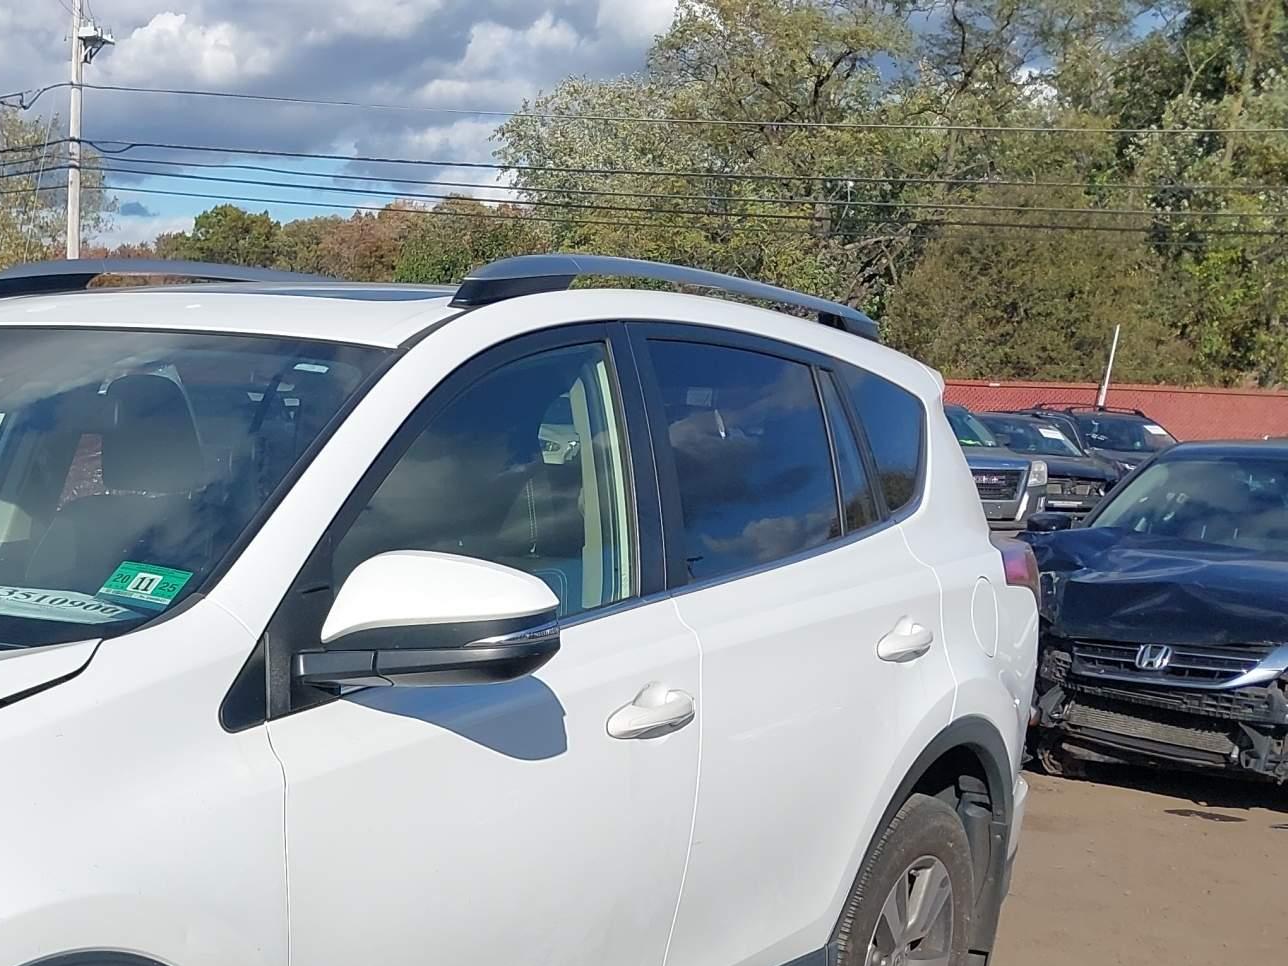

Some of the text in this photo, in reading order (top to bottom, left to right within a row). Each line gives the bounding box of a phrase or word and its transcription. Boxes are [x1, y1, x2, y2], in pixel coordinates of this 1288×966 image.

[113, 573, 179, 593] 20 11 25
